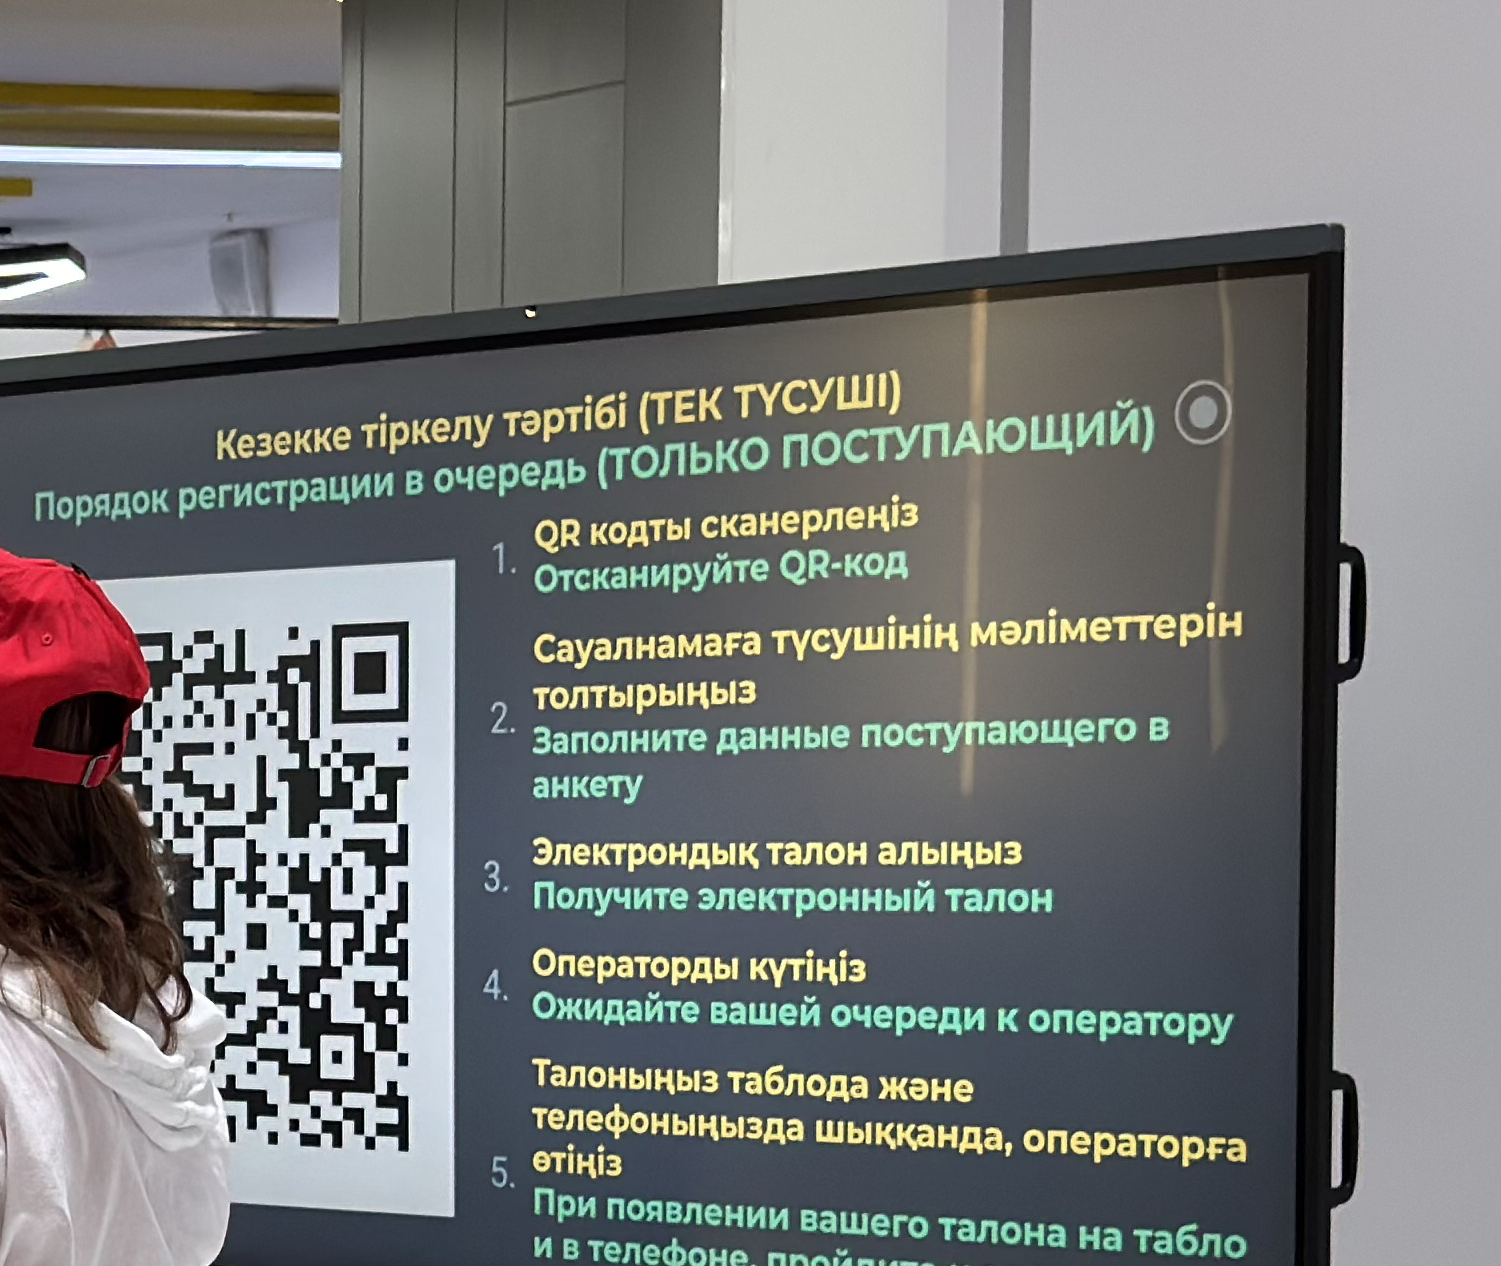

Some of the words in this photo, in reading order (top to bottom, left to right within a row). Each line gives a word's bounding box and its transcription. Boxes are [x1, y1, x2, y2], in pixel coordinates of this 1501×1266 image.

[216, 421, 352, 461] Кезекке
[361, 411, 494, 455] тіркелу
[503, 394, 629, 444] тәртібі
[639, 383, 724, 436] (ТЕК
[734, 369, 902, 422] ТҮСУШІ)
[35, 486, 169, 527] Порядок
[178, 468, 395, 518] регистрации
[406, 471, 424, 495] в
[433, 455, 587, 499] очередь
[598, 439, 770, 490] (ТОЛЬКО
[781, 399, 1156, 475] ПОСТУПАЮЩИЙ)
[534, 518, 584, 554] QR
[589, 513, 691, 550] кодты
[701, 496, 919, 544] сканерлеңіз
[493, 542, 517, 575] 1.
[533, 556, 770, 596] Отсканируйте
[780, 547, 909, 586] QR-код
[533, 626, 762, 668] Сауалнамаға
[772, 615, 959, 662] түсушінің
[970, 603, 1243, 653] мәліметтерін
[533, 679, 758, 713] толтырыңыз
[490, 702, 516, 735] 2.
[532, 724, 708, 757] Заполните
[716, 721, 850, 757] данные
[860, 715, 1137, 755] поступающего
[1149, 715, 1170, 743] в
[532, 771, 644, 804] анкету
[532, 836, 760, 871] Электрондық
[766, 839, 868, 867] талон
[878, 836, 1024, 871] алыңыз
[482, 860, 510, 894] 3.
[532, 880, 690, 917] Получите
[697, 880, 936, 919] электронный
[946, 886, 1055, 915] талон
[482, 968, 510, 1003] 4.
[532, 949, 740, 985] Операторды
[749, 949, 868, 988] күтіңіз
[532, 991, 700, 1026] Ожидайте
[710, 995, 822, 1029] вашей
[831, 1003, 986, 1039] очереди
[998, 1007, 1019, 1033] к
[1028, 1008, 1235, 1046] оператору
[532, 1058, 720, 1096] Талоныңыз
[728, 1065, 870, 1105] таблода
[879, 1075, 974, 1105] және
[532, 1102, 805, 1147] телефоныңызда
[815, 1117, 1014, 1157] шыққанда,
[1023, 1127, 1249, 1165] операторға
[490, 1155, 516, 1190] 5.
[532, 1145, 623, 1181] өтіңіз
[532, 1186, 598, 1224] При
[606, 1192, 790, 1233] появлении
[799, 1209, 929, 1243] вашего
[939, 1216, 1068, 1250] талона
[1078, 1224, 1124, 1254] на
[1133, 1224, 1249, 1261] табло
[532, 1234, 553, 1261] и
[562, 1235, 581, 1264] в
